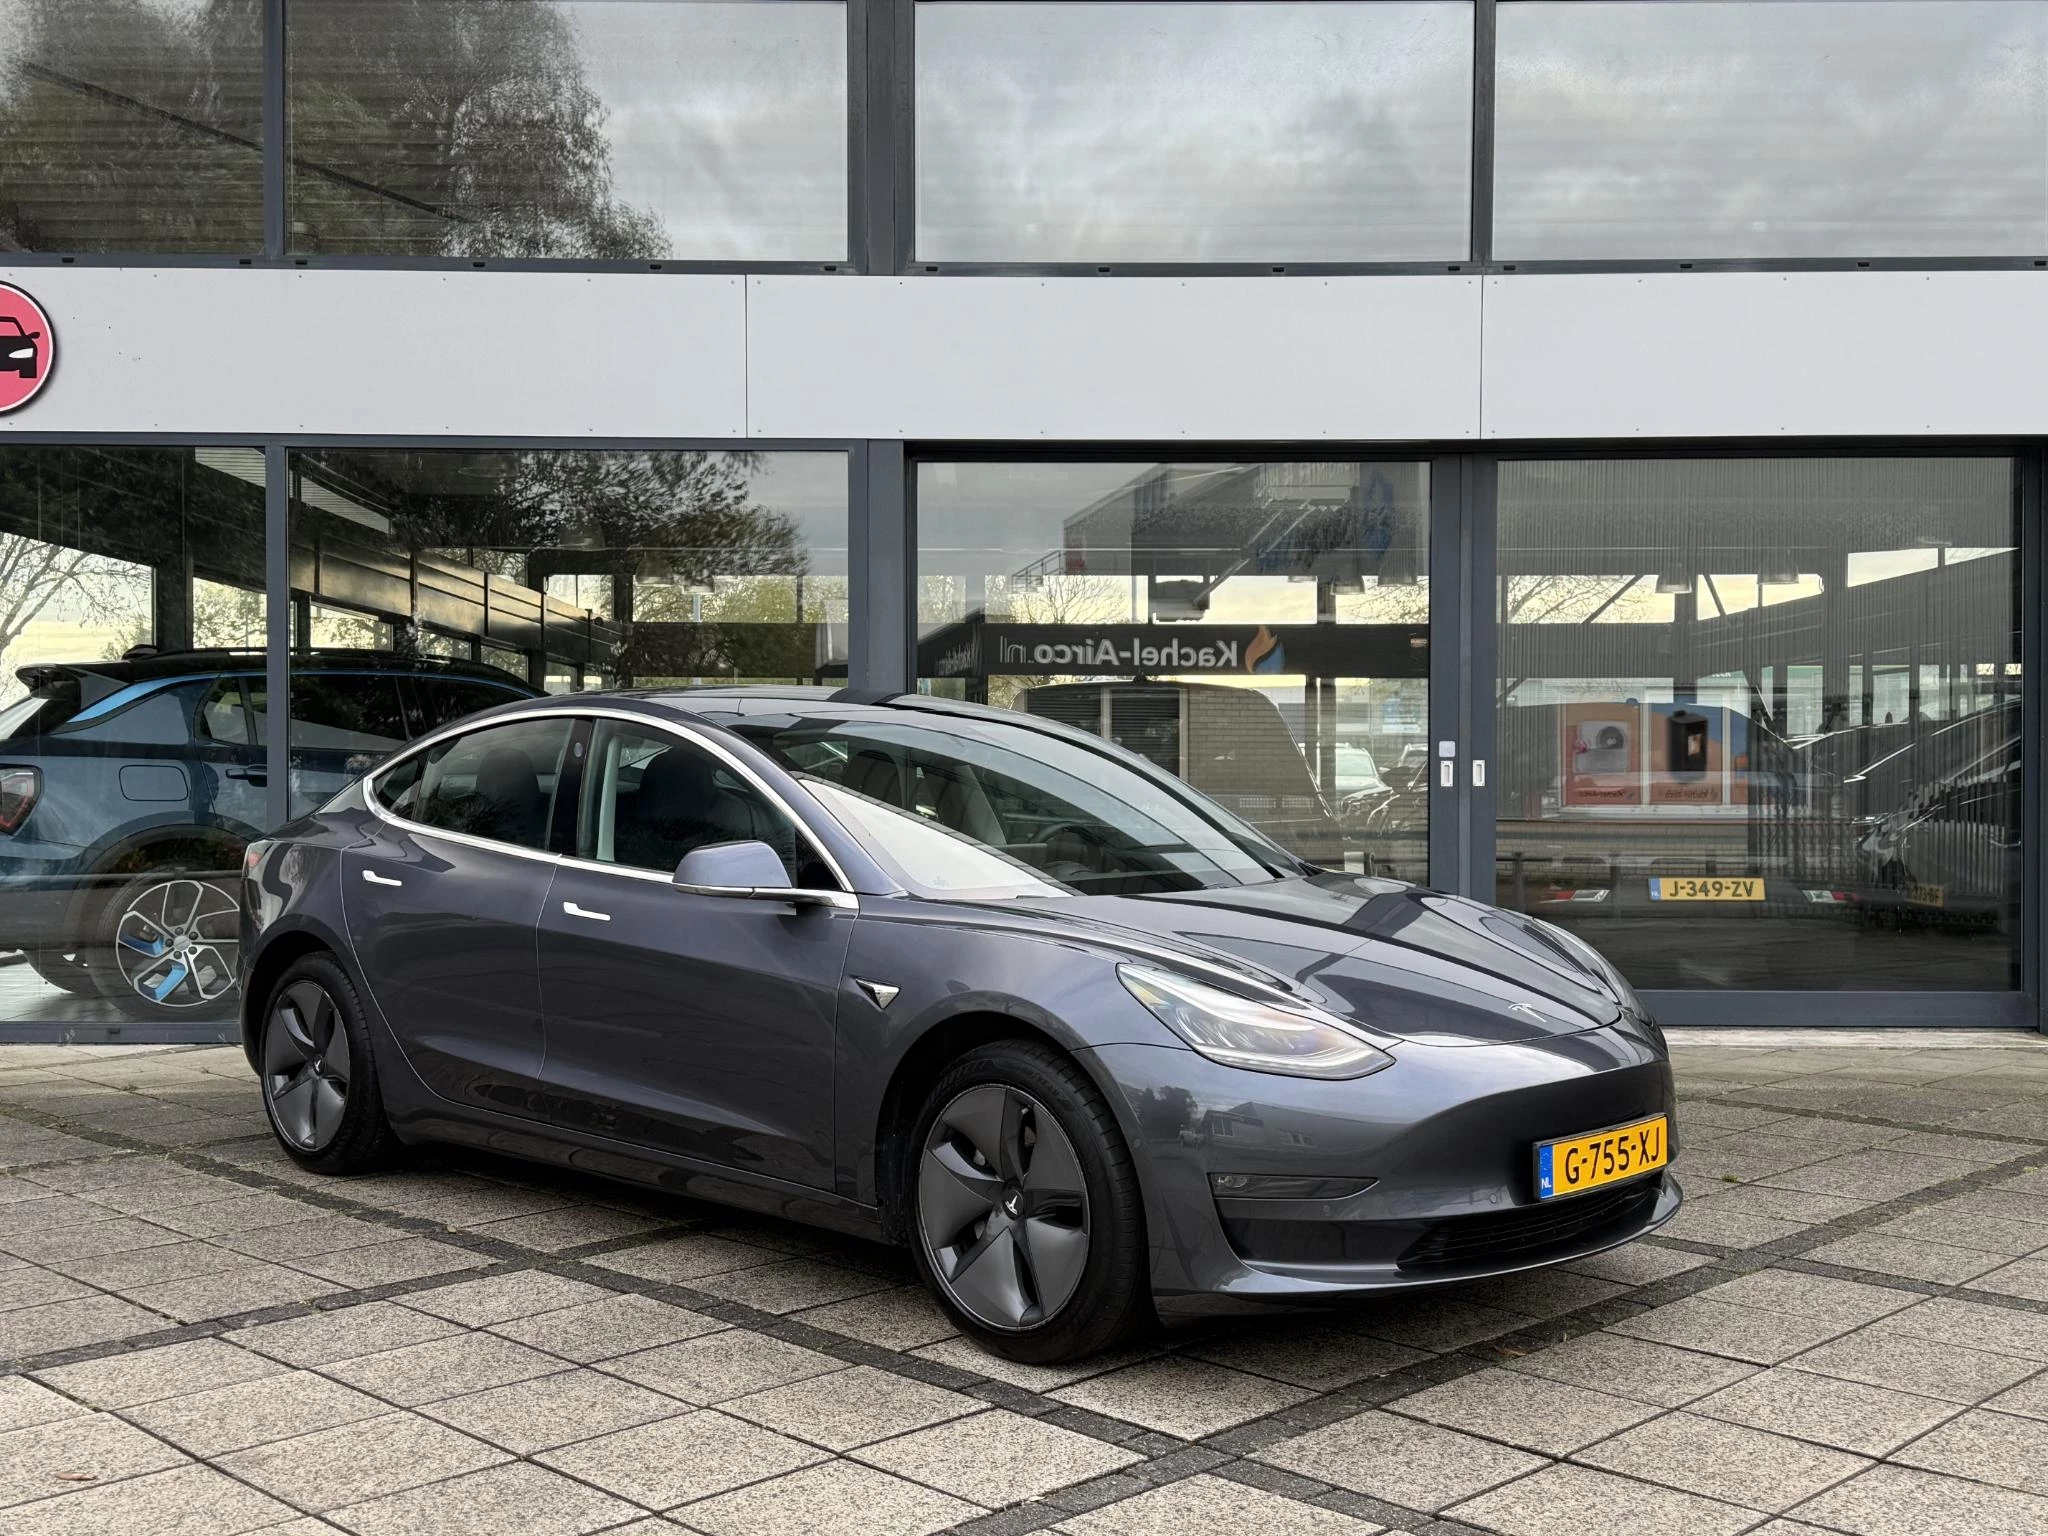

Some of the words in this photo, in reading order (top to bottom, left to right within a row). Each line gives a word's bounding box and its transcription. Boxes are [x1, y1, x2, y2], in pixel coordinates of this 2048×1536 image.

[1669, 881, 1754, 898] J-349-ZV
[1565, 1126, 1660, 1185] G-755-XJ
[1541, 1177, 1552, 1190] NL
